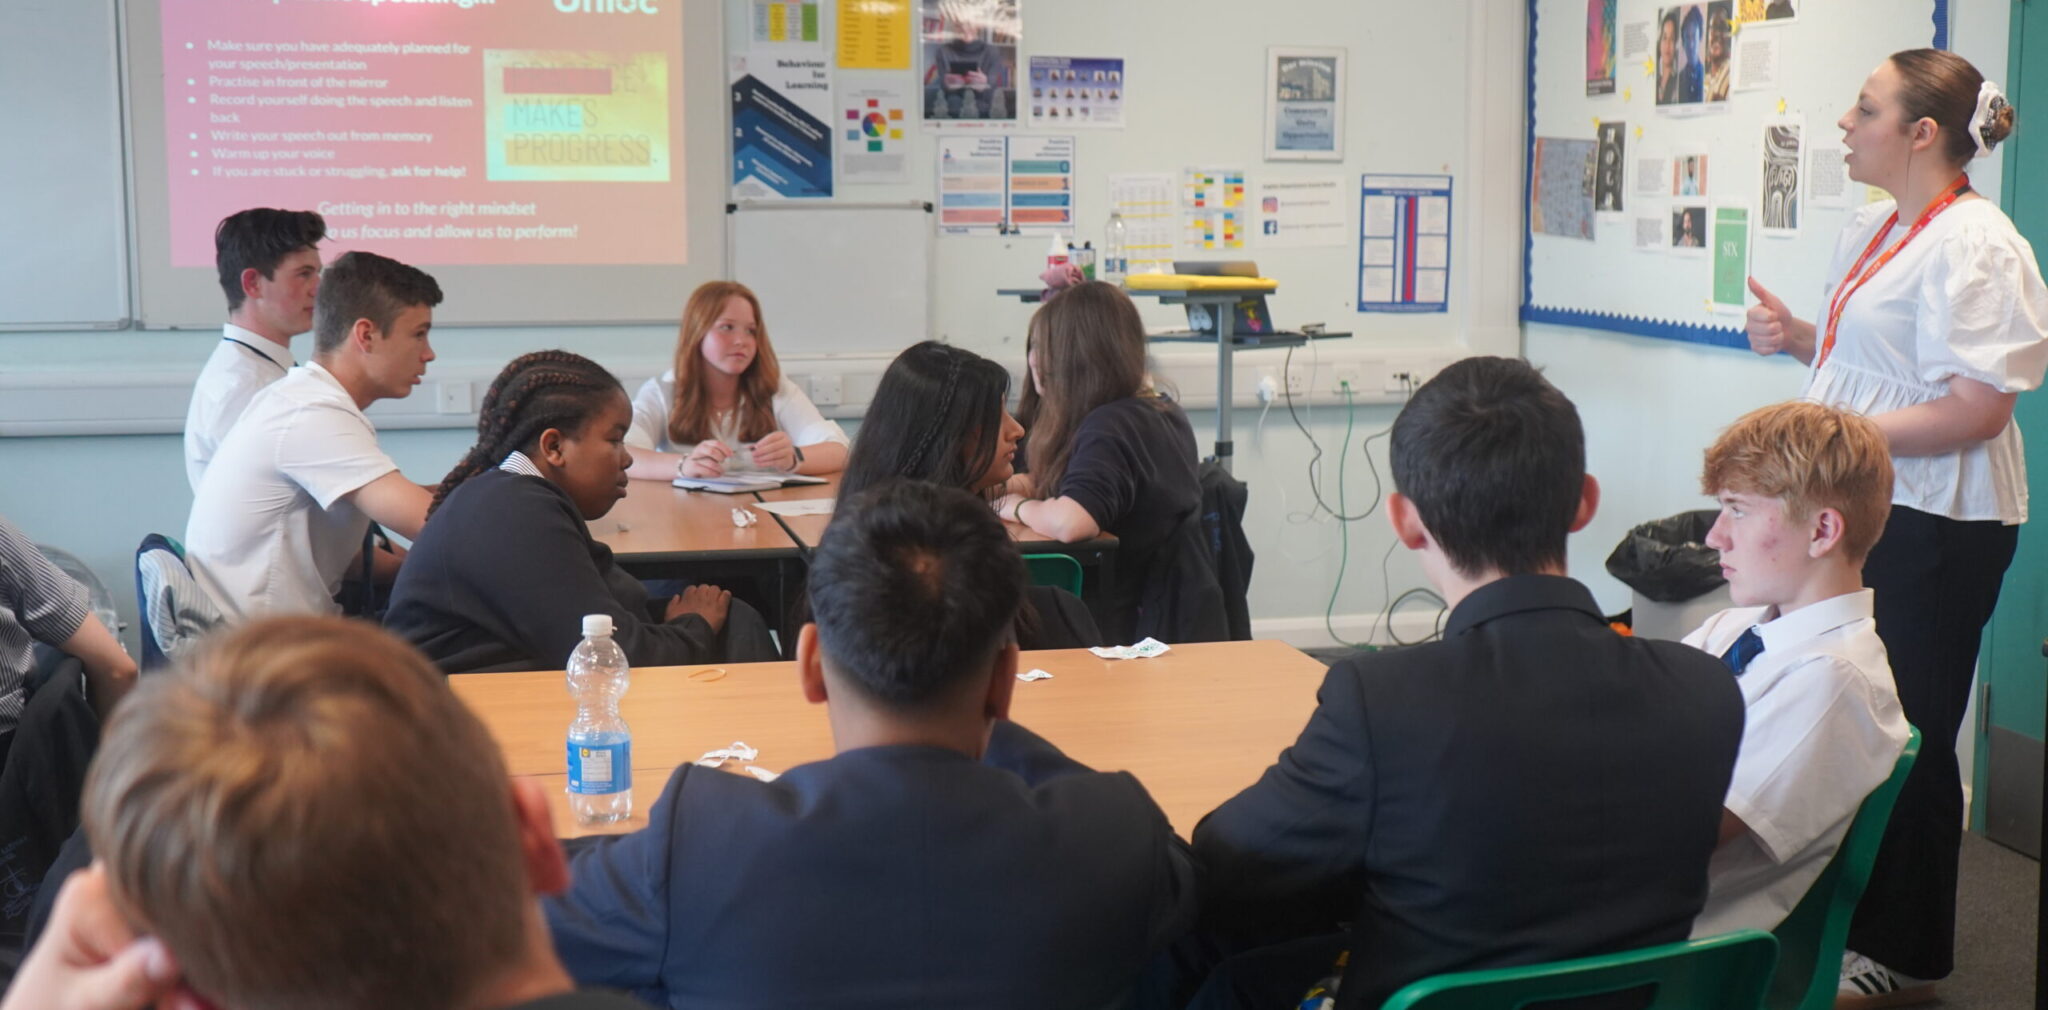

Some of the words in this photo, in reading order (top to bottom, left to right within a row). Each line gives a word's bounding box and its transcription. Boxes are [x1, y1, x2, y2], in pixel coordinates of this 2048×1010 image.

[208, 40, 242, 51] Make
[245, 43, 274, 52] sure
[276, 43, 298, 54] you
[301, 41, 330, 52] have
[333, 42, 399, 55] adequately
[402, 42, 450, 55] planned
[453, 43, 471, 54] for
[208, 61, 236, 71] your
[240, 59, 367, 71] speech/presentation
[209, 76, 260, 87] Practise
[263, 77, 275, 87] in
[277, 76, 308, 87] front
[310, 76, 324, 87] of
[326, 77, 346, 88] the
[348, 78, 388, 88] mirror
[210, 94, 255, 105] Record
[258, 95, 307, 107] yourself
[310, 95, 345, 108] doing
[347, 96, 367, 106] the
[369, 96, 412, 108] speech
[415, 97, 437, 107] and
[439, 96, 472, 107] listen
[210, 112, 240, 123] back
[513, 98, 598, 128] MAKES
[210, 131, 249, 141] Write
[251, 133, 278, 143] your
[282, 131, 325, 143] speech
[327, 132, 348, 142] out
[350, 131, 380, 142] from
[382, 133, 433, 144] memory
[212, 149, 250, 159] Warm
[253, 150, 270, 161] up
[272, 150, 301, 161] your
[303, 149, 335, 159] voice
[212, 166, 223, 177] If
[225, 168, 248, 178] you
[251, 168, 271, 177] are
[273, 166, 305, 177] stuck
[308, 168, 322, 177] or
[324, 166, 388, 179] struggling,
[391, 165, 412, 177] ask
[413, 165, 432, 177] for
[434, 165, 466, 179] help!
[317, 201, 373, 217] Getting
[377, 202, 392, 215] in
[395, 203, 409, 215] to
[412, 202, 436, 215] the
[440, 202, 474, 218] right
[478, 202, 537, 216] mindset
[341, 228, 358, 239] us
[360, 225, 399, 242] focus
[402, 224, 431, 239] and
[434, 224, 473, 239] allow
[476, 228, 493, 239] us
[496, 226, 511, 239] to
[514, 224, 578, 242] perform!
